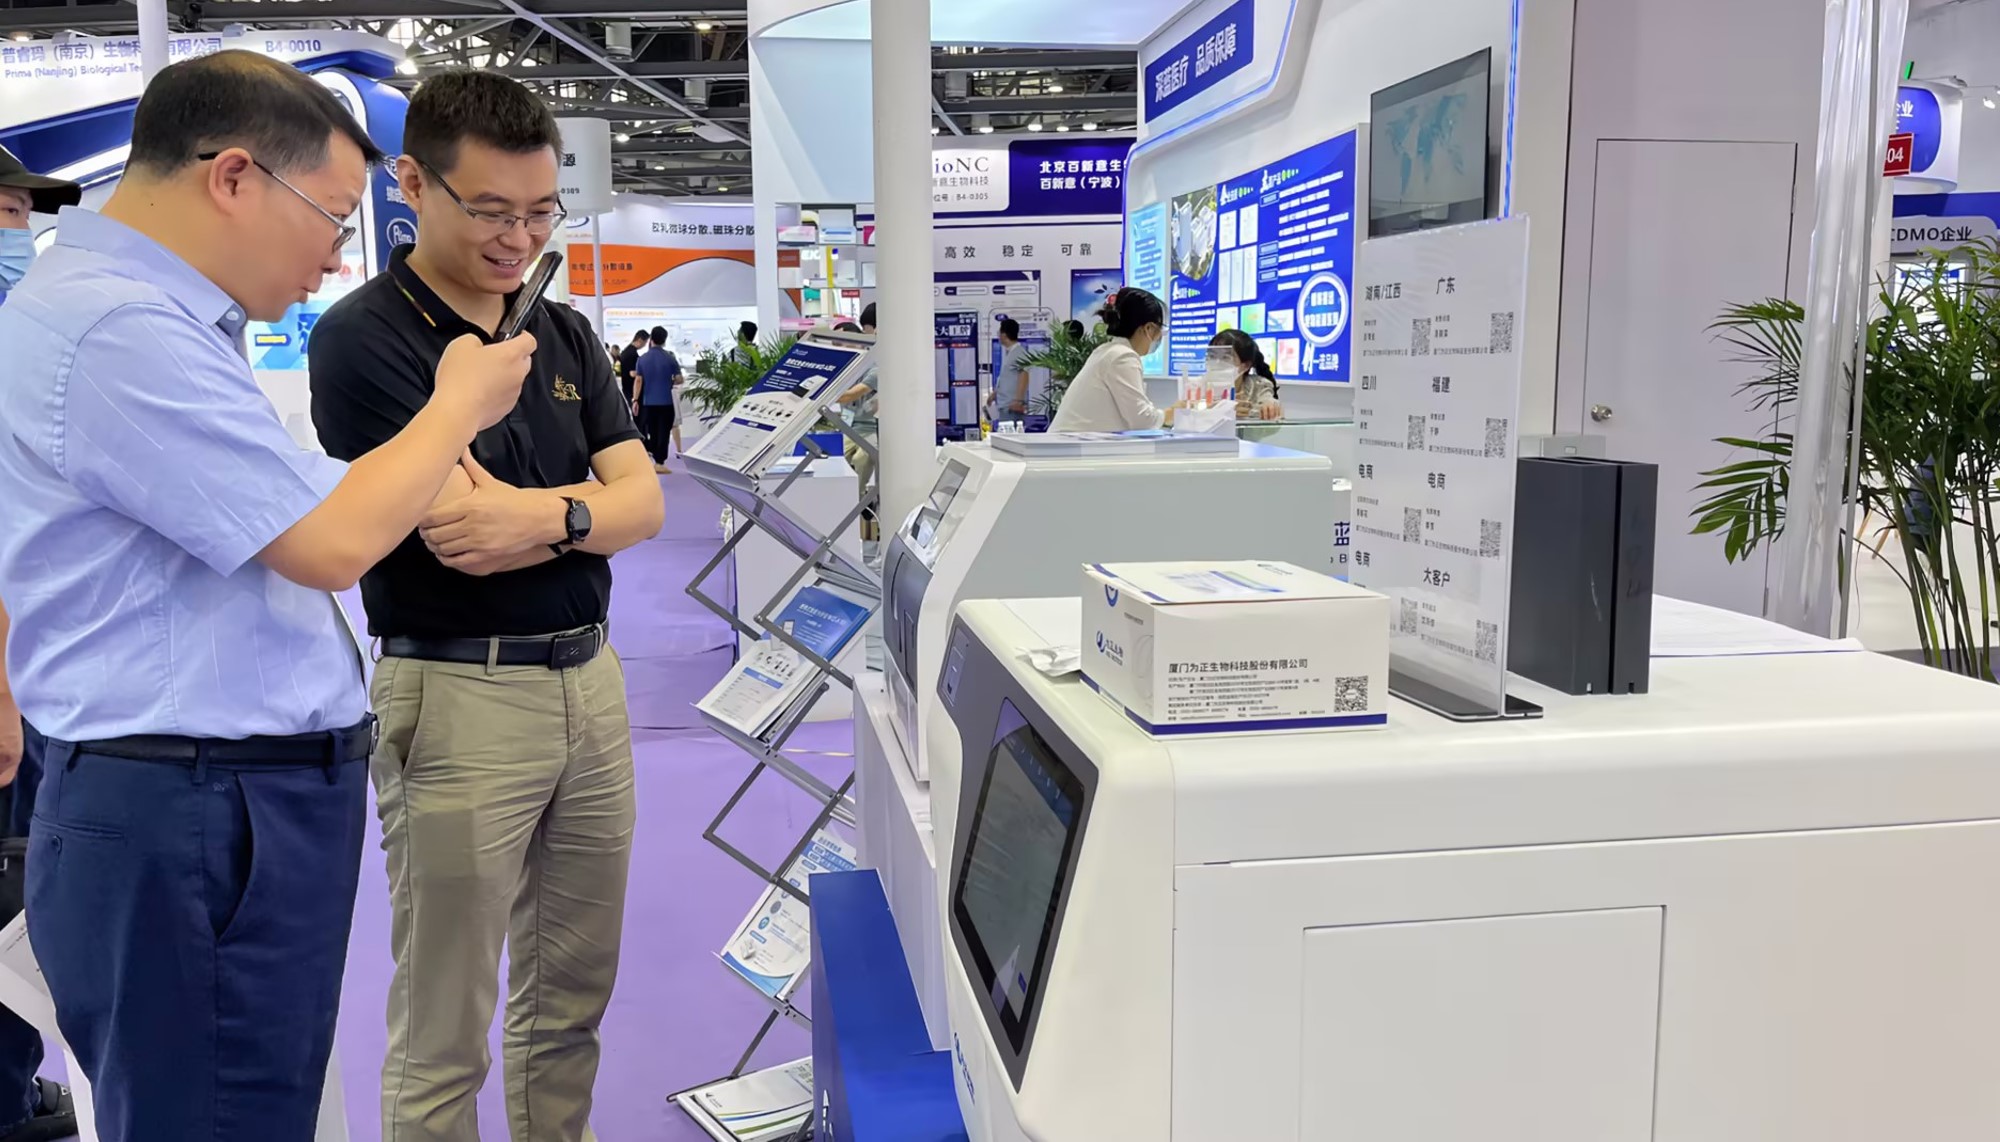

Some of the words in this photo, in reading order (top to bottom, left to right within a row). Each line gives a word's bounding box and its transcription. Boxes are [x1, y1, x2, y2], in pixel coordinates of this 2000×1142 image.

[265, 39, 321, 53] B4-0010
[5, 69, 32, 78] Prima
[35, 66, 78, 78] (Nanjing)
[80, 63, 127, 76] Biological
[1155, 54, 1189, 103] 深蓝医疗
[1195, 23, 1237, 78] 品质保障
[934, 157, 990, 174] ioNC
[945, 246, 976, 259] 高效
[1002, 244, 1034, 258] 稳定
[1061, 243, 1092, 256] 可靠
[1365, 282, 1401, 301] 湖南/江西
[1436, 277, 1456, 295] 广东
[1361, 375, 1377, 391] 四川
[1432, 376, 1451, 394] 福建
[1358, 463, 1374, 481] 电商
[1427, 471, 1446, 490] 电商
[1355, 550, 1371, 568] 电商
[1423, 567, 1451, 588] 大客户
[1168, 658, 1308, 673] 厦门为正生物科技股份有限公司
